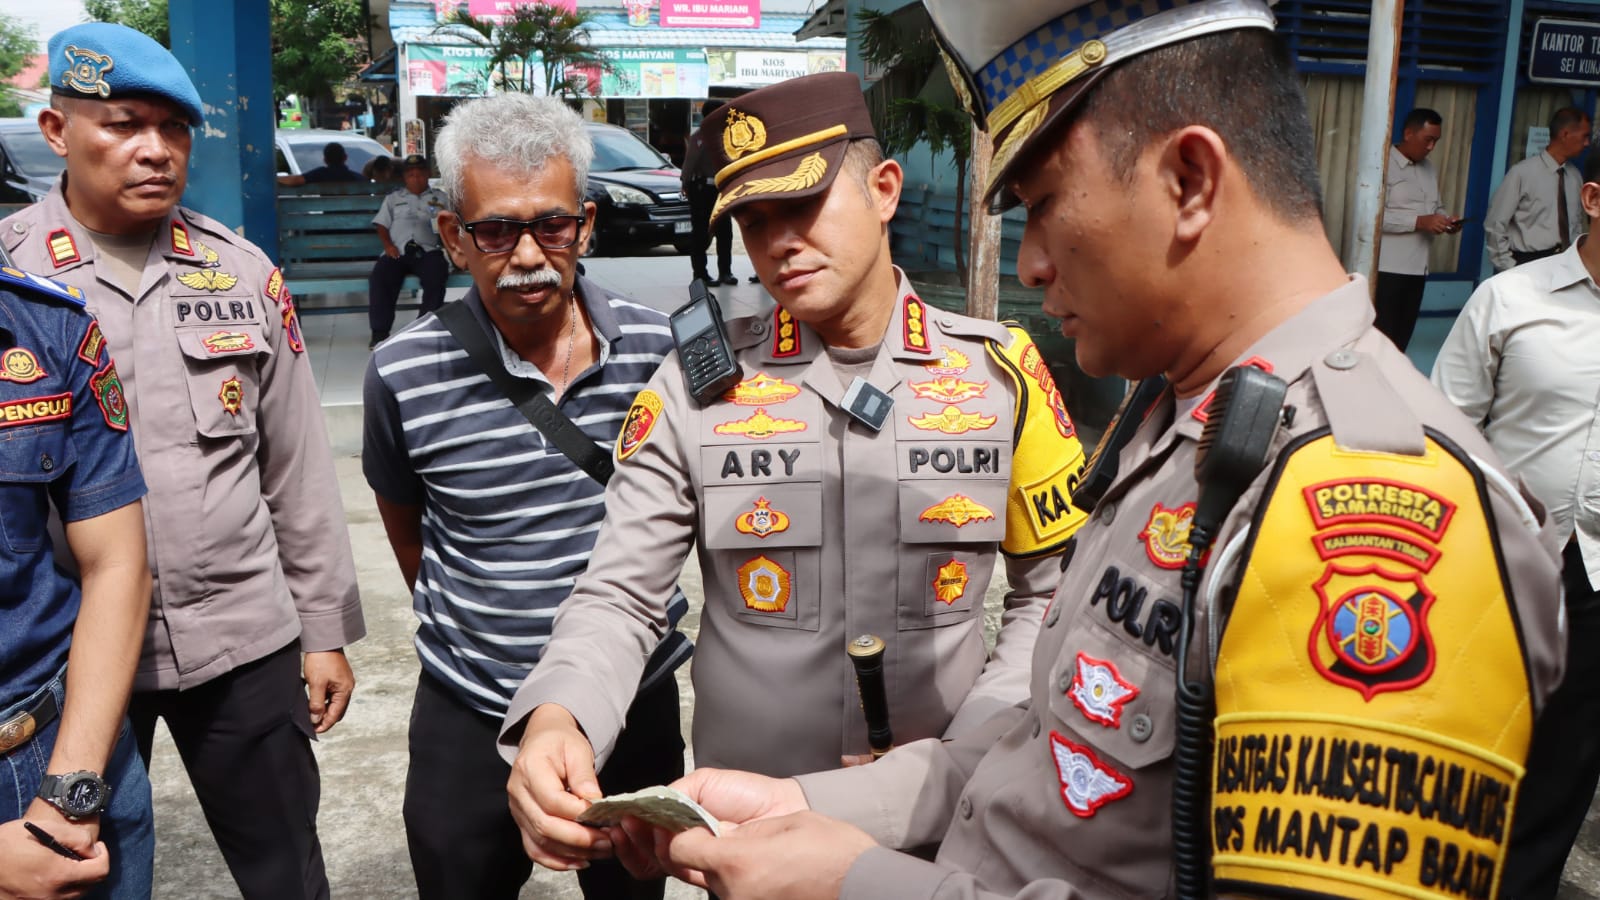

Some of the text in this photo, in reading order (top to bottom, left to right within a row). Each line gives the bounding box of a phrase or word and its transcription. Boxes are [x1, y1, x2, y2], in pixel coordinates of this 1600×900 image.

[692, 4, 708, 13] IBU
[709, 5, 748, 14] MARIANI
[442, 47, 472, 57] KIOS
[1541, 32, 1585, 54] KANTOR
[622, 50, 675, 60] MARIYANI
[762, 58, 785, 67] KIOS
[1560, 57, 1576, 73] SEI
[741, 68, 806, 78] IBU MARIYANI
[176, 300, 255, 322] POLRI
[720, 448, 800, 479] ARY
[908, 447, 999, 474] POLRI
[1315, 483, 1441, 518] POLRESTA
[1321, 500, 1437, 531] SAMARINDA
[1323, 535, 1395, 551] KALIMANTAN
[1090, 565, 1182, 660] POLR
[1254, 806, 1409, 876] MANTAP
